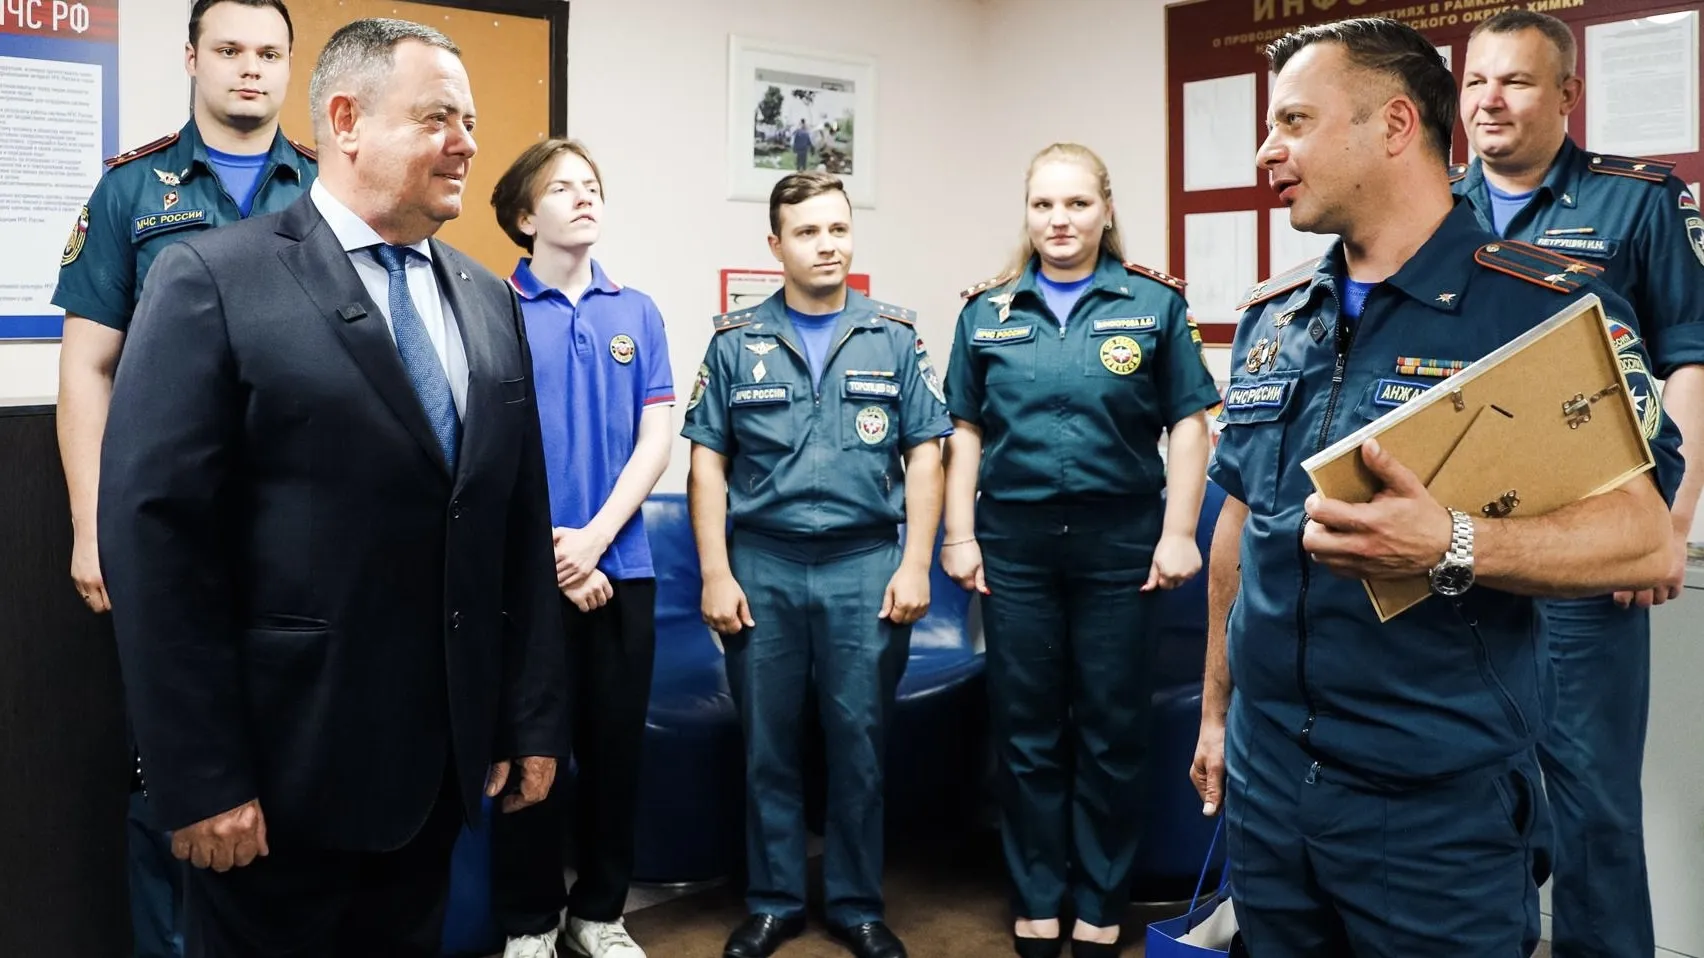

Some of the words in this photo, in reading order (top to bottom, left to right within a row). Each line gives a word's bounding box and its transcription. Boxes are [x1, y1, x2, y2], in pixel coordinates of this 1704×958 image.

[1430, 3, 1440, 14] В
[1526, 0, 1584, 13] ХИМКИ
[53, 0, 89, 33] РФ
[136, 216, 156, 230] МЧС
[160, 210, 203, 224] РОССИИ
[736, 389, 752, 401] МЧС
[753, 387, 786, 400] РОССИИ
[1247, 385, 1281, 402] РОССИИ
[1381, 384, 1426, 401] АНЖА
